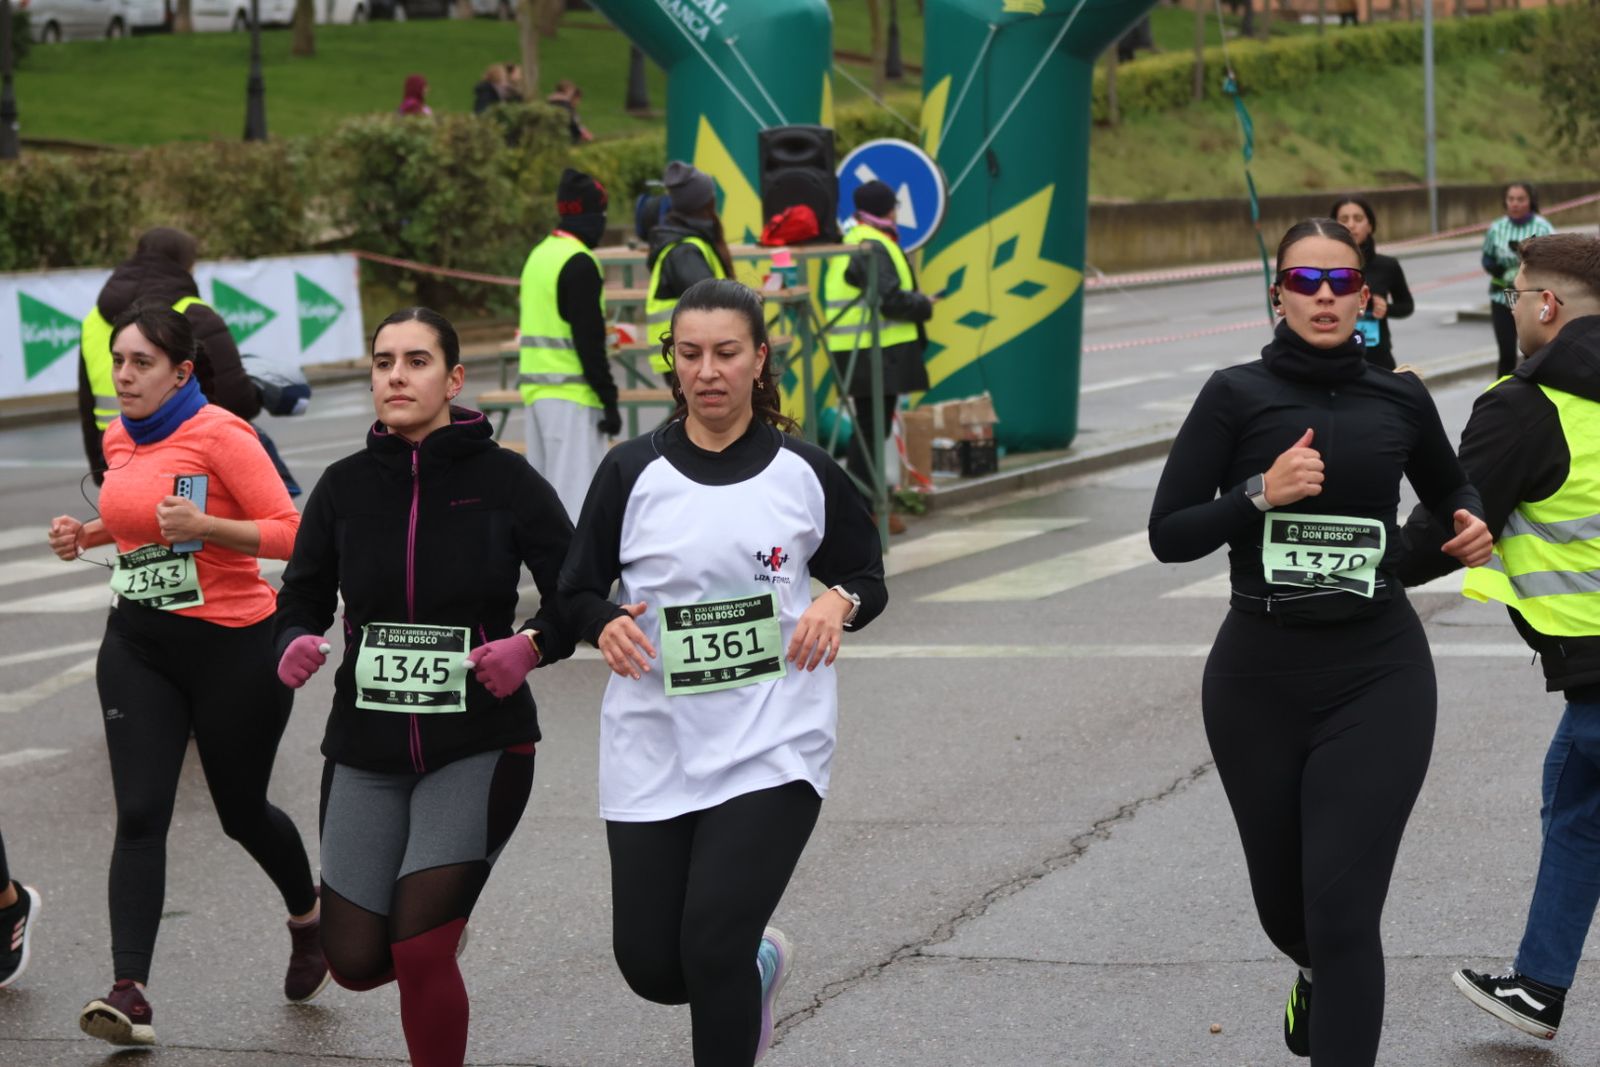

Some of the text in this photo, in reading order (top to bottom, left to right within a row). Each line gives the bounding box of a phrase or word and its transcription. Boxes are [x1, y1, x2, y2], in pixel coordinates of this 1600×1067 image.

[1302, 531, 1354, 541] DON BOSCO
[124, 565, 182, 594] 1343
[708, 604, 734, 612] CARRERA
[735, 600, 761, 609] POPULAR
[694, 609, 745, 622] DON BOSCO
[388, 634, 438, 645] DON BOSCO
[428, 630, 454, 638] POPULAR
[682, 627, 765, 664] 1361
[372, 655, 450, 685] 1345
